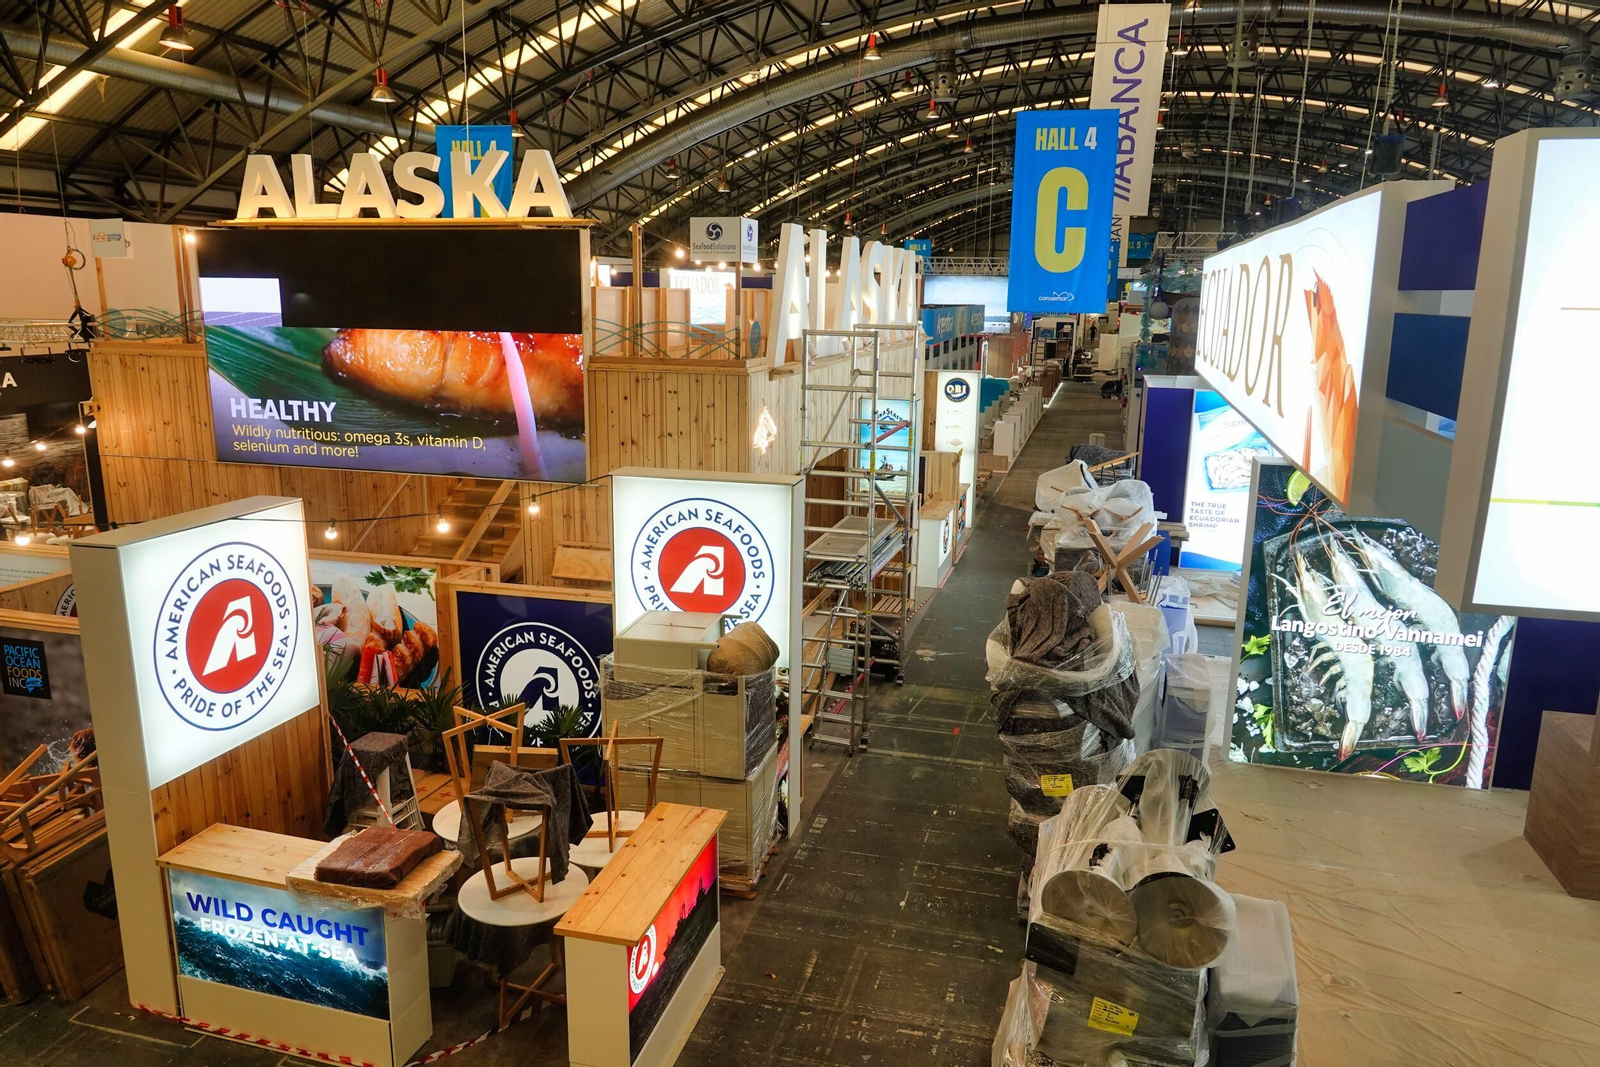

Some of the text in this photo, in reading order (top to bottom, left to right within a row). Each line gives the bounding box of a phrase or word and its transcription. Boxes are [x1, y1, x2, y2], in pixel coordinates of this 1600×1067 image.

[1035, 126, 1098, 151] HALL 4
[238, 149, 573, 218] ALASKA
[1034, 166, 1090, 273] C
[692, 242, 737, 250] SeafoodSolutions
[767, 222, 917, 367] ALASKA
[1196, 252, 1294, 419] ECUADOR
[229, 397, 337, 423] HEALTHY
[231, 424, 487, 452] Wildly nutritious: omega 3s, vitamin D,
[233, 439, 360, 459] selenium and more!
[1189, 514, 1240, 524] ECUADORIAN
[1190, 508, 1214, 516] TASTE
[1207, 502, 1228, 510] TRUE
[1188, 521, 1218, 529] SHRIMP
[640, 507, 766, 580] AMERICAN SEAFOODS
[165, 554, 291, 661] AMERICAN SEAFOODS
[739, 593, 762, 619] SEA
[1322, 592, 1417, 635] El mejor
[1270, 615, 1485, 648] Langostino Vannamei
[4, 644, 40, 659] PACIFIC
[5, 655, 41, 670] OCEAN
[1334, 641, 1412, 658] DESDE 1984
[7, 666, 43, 681] FOODS
[173, 634, 291, 719] PRIDE OF THE SEA
[484, 631, 597, 700] AMERICAN SEAFOODS
[8, 677, 26, 689] INC
[186, 891, 370, 947] WILD CAUGHT
[200, 916, 360, 965] FROZEN-AT-SEA
